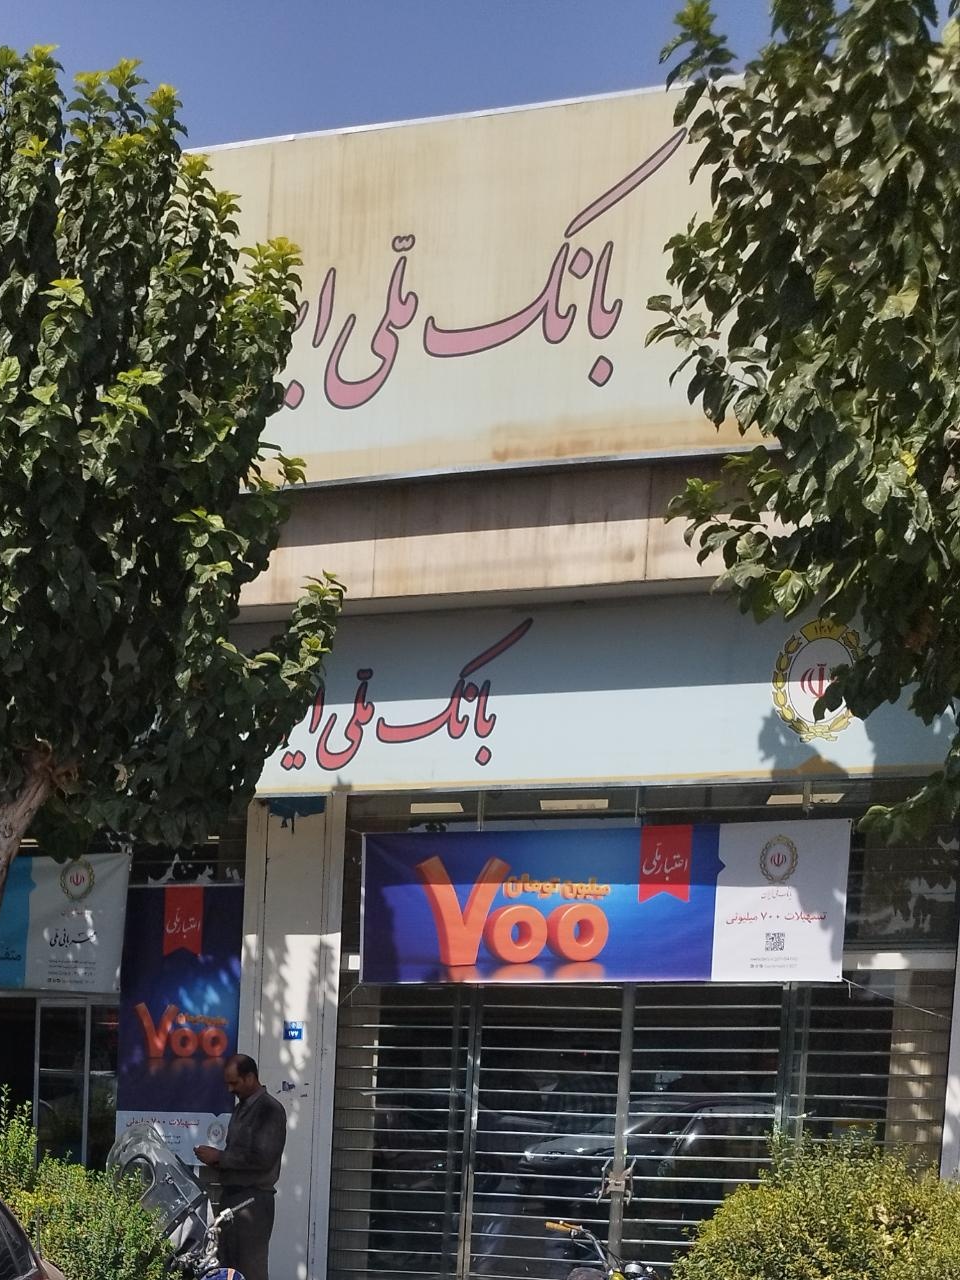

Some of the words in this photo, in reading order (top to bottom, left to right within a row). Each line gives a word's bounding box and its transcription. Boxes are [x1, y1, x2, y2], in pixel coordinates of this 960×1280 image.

[424, 127, 688, 387] بانک
[376, 617, 534, 766] بانک
[502, 873, 560, 899] تومان
[560, 877, 611, 900] میلیون
[725, 911, 758, 925] میلیونی
[784, 911, 828, 924] تسهیلات
